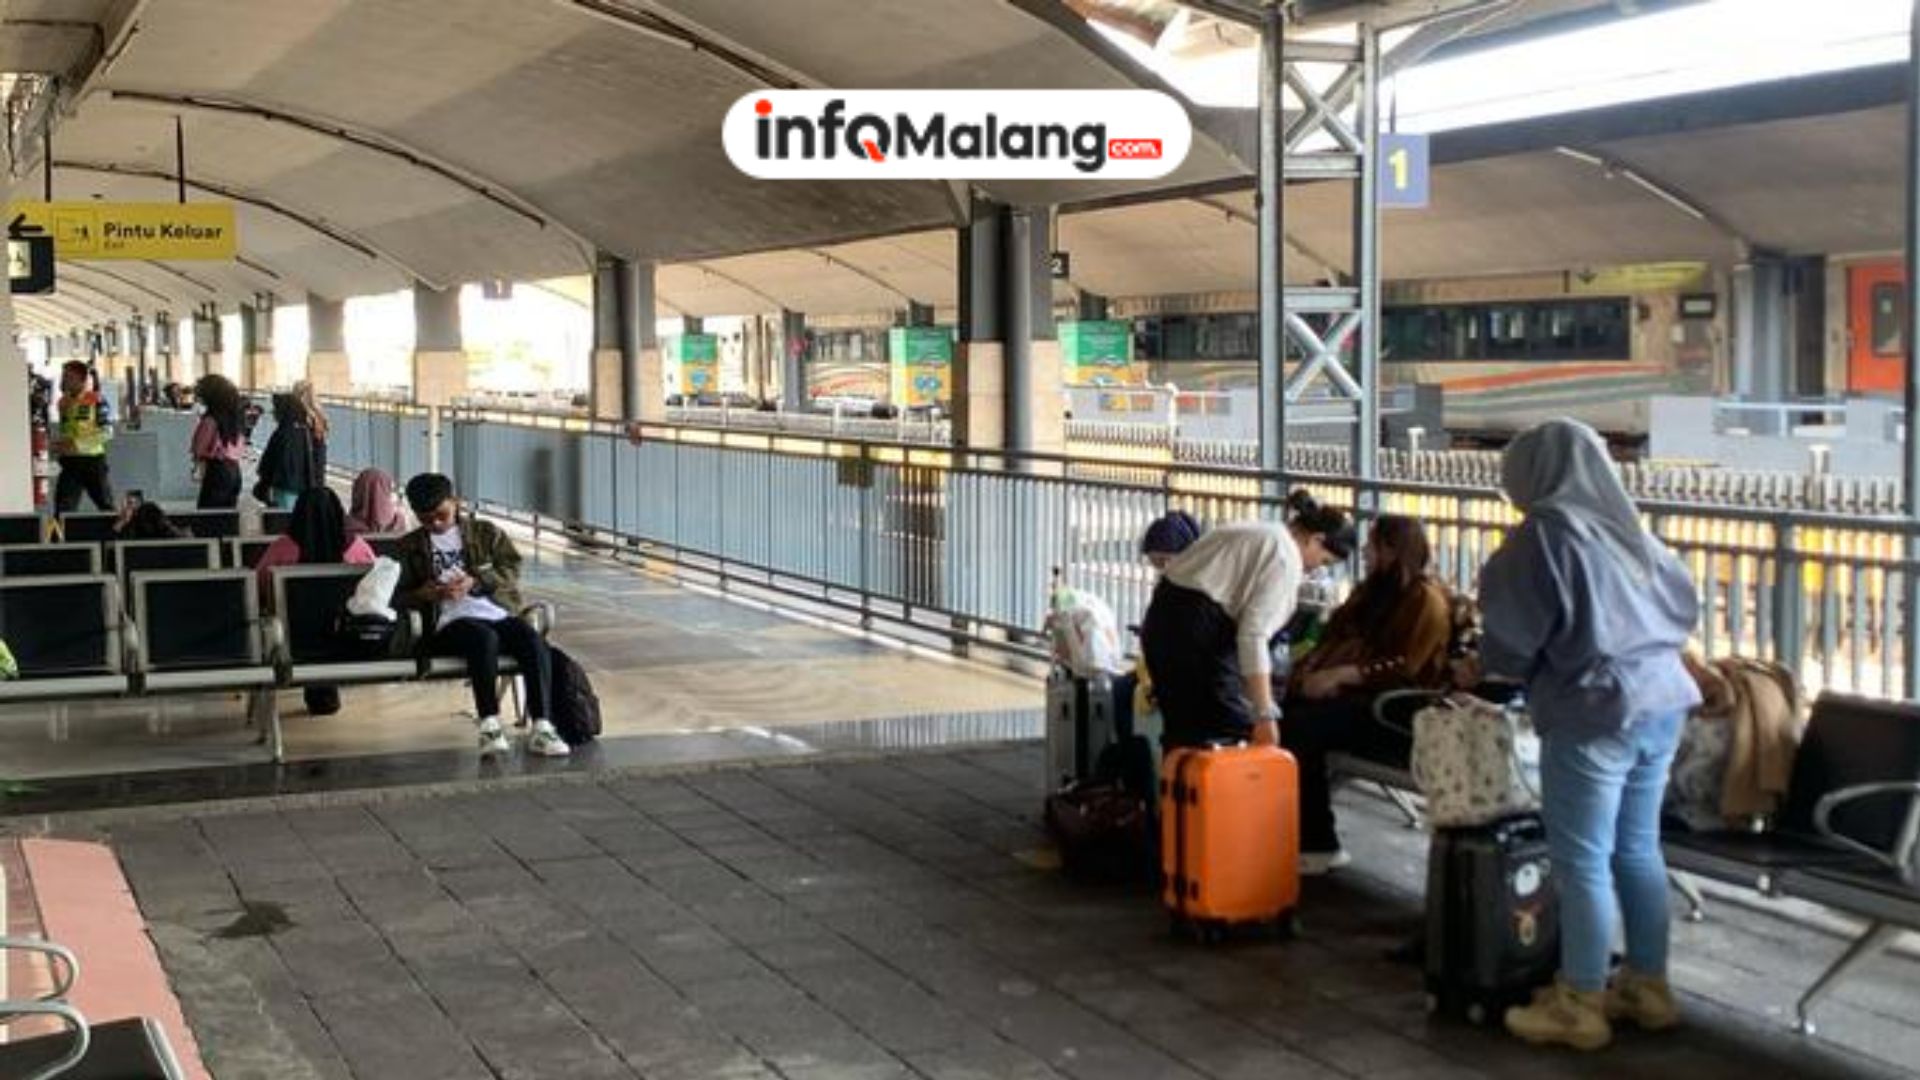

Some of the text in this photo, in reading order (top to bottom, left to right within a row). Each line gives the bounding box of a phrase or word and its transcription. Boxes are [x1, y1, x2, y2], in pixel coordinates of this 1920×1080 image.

[1389, 148, 1408, 190] 1
[103, 222, 223, 239] Pintu Keluar
[1051, 258, 1063, 274] 2
